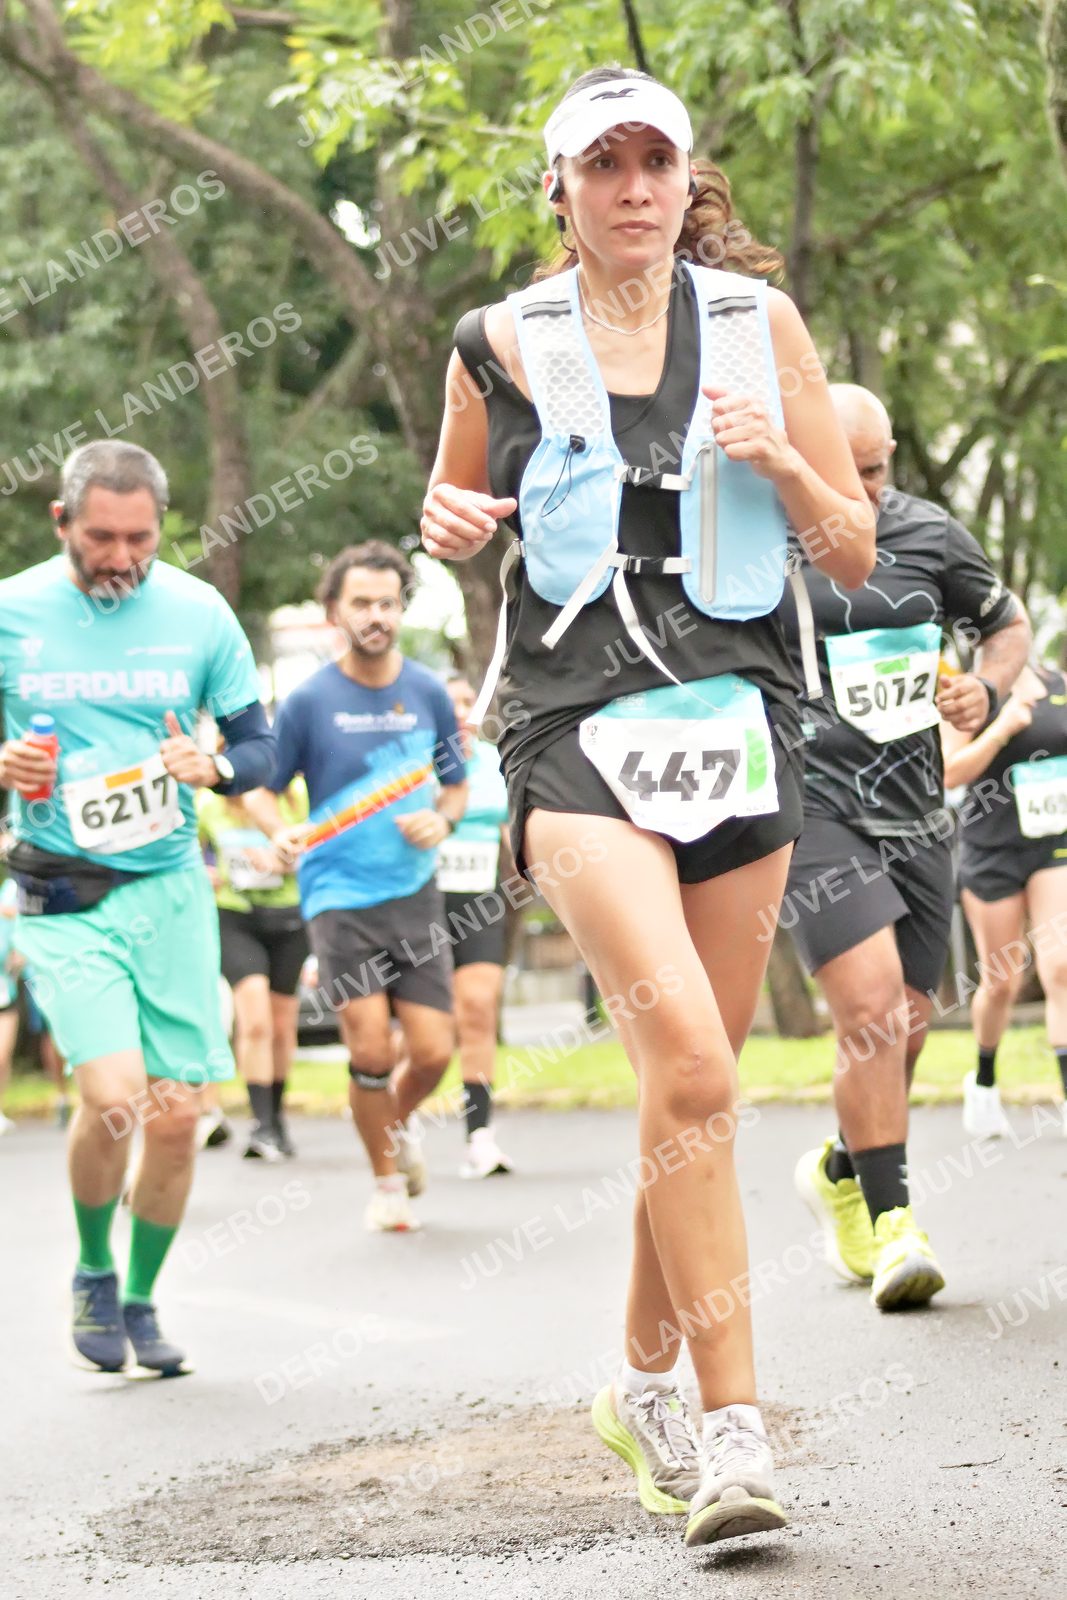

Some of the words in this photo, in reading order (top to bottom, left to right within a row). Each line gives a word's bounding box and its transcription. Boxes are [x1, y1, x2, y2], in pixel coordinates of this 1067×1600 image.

[20, 670, 191, 700] PERDURA
[618, 749, 740, 801] 447
[81, 773, 170, 830] 6217
